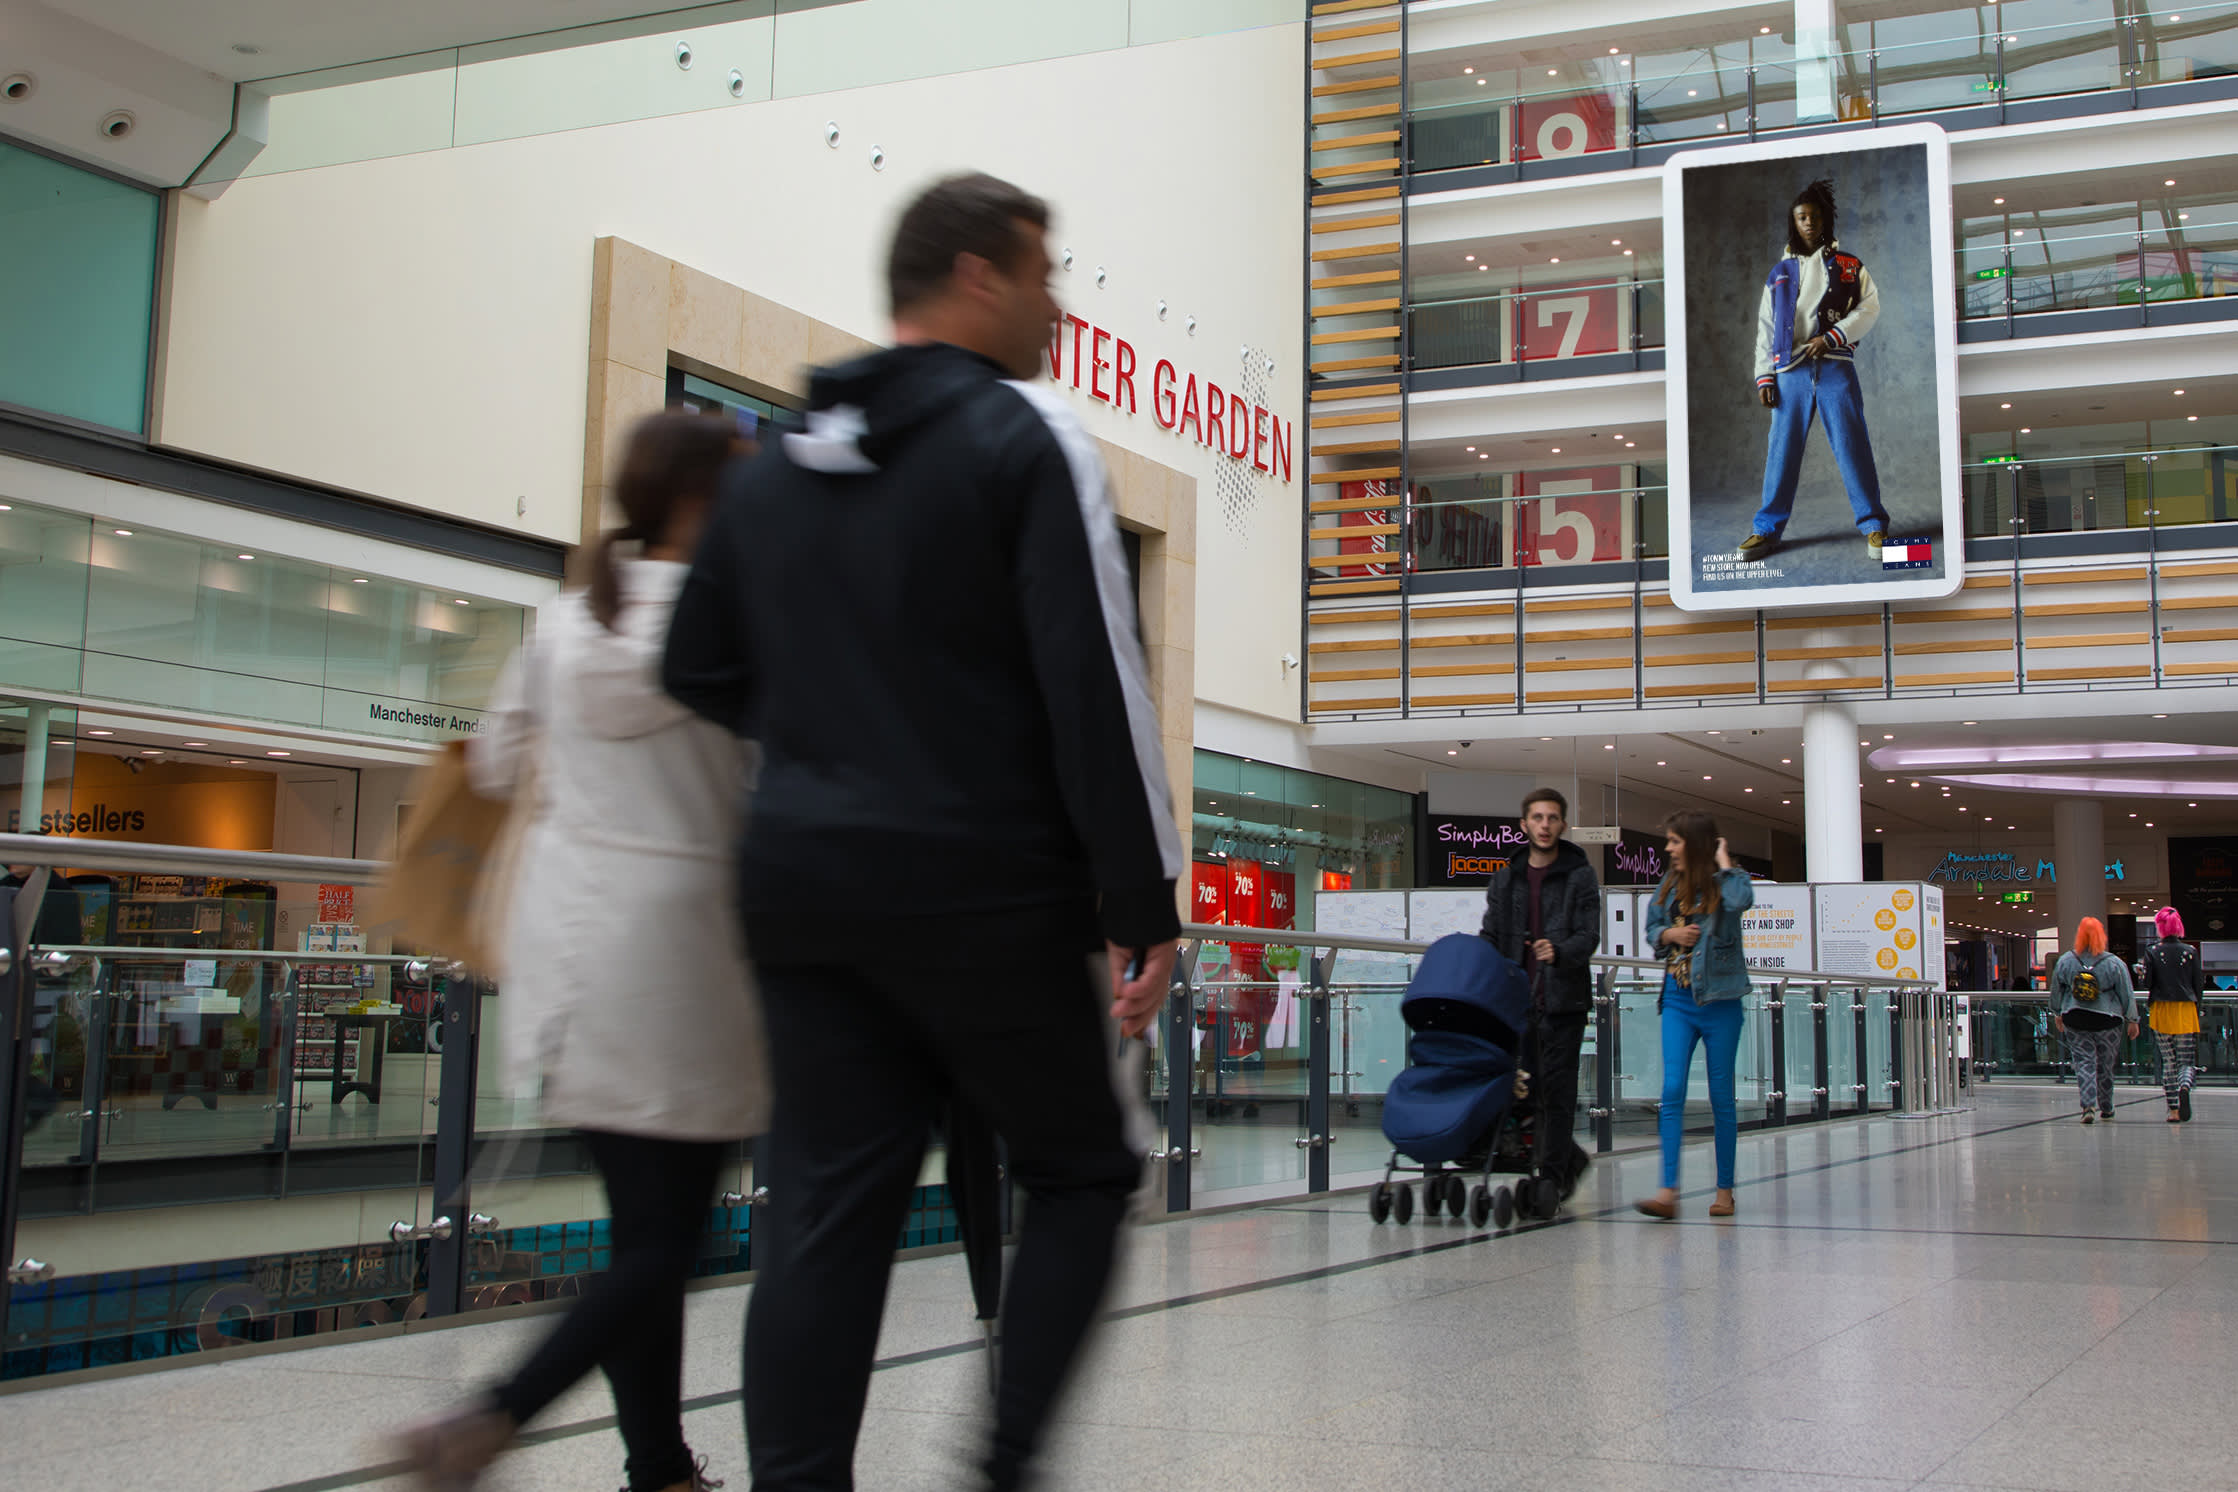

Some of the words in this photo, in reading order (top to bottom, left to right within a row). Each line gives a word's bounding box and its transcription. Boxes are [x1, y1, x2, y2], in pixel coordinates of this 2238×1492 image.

[1538, 296, 1590, 358] 7
[1049, 308, 1137, 415] NTER
[1152, 358, 1292, 483] GARDEN
[1539, 479, 1596, 564] 5
[1716, 562, 1735, 571] STORE
[369, 703, 446, 729] Manchester
[7, 803, 145, 834] Bstsellers
[1448, 852, 1510, 878] jacam
[1928, 857, 2031, 882] Arndale
[2036, 858, 2125, 882] Met
[1947, 851, 2014, 863] Manchester
[232, 921, 255, 933] TIME
[1758, 919, 1773, 930] AND
[1775, 919, 1795, 930] SHOP
[1760, 956, 1785, 968] INSIDE
